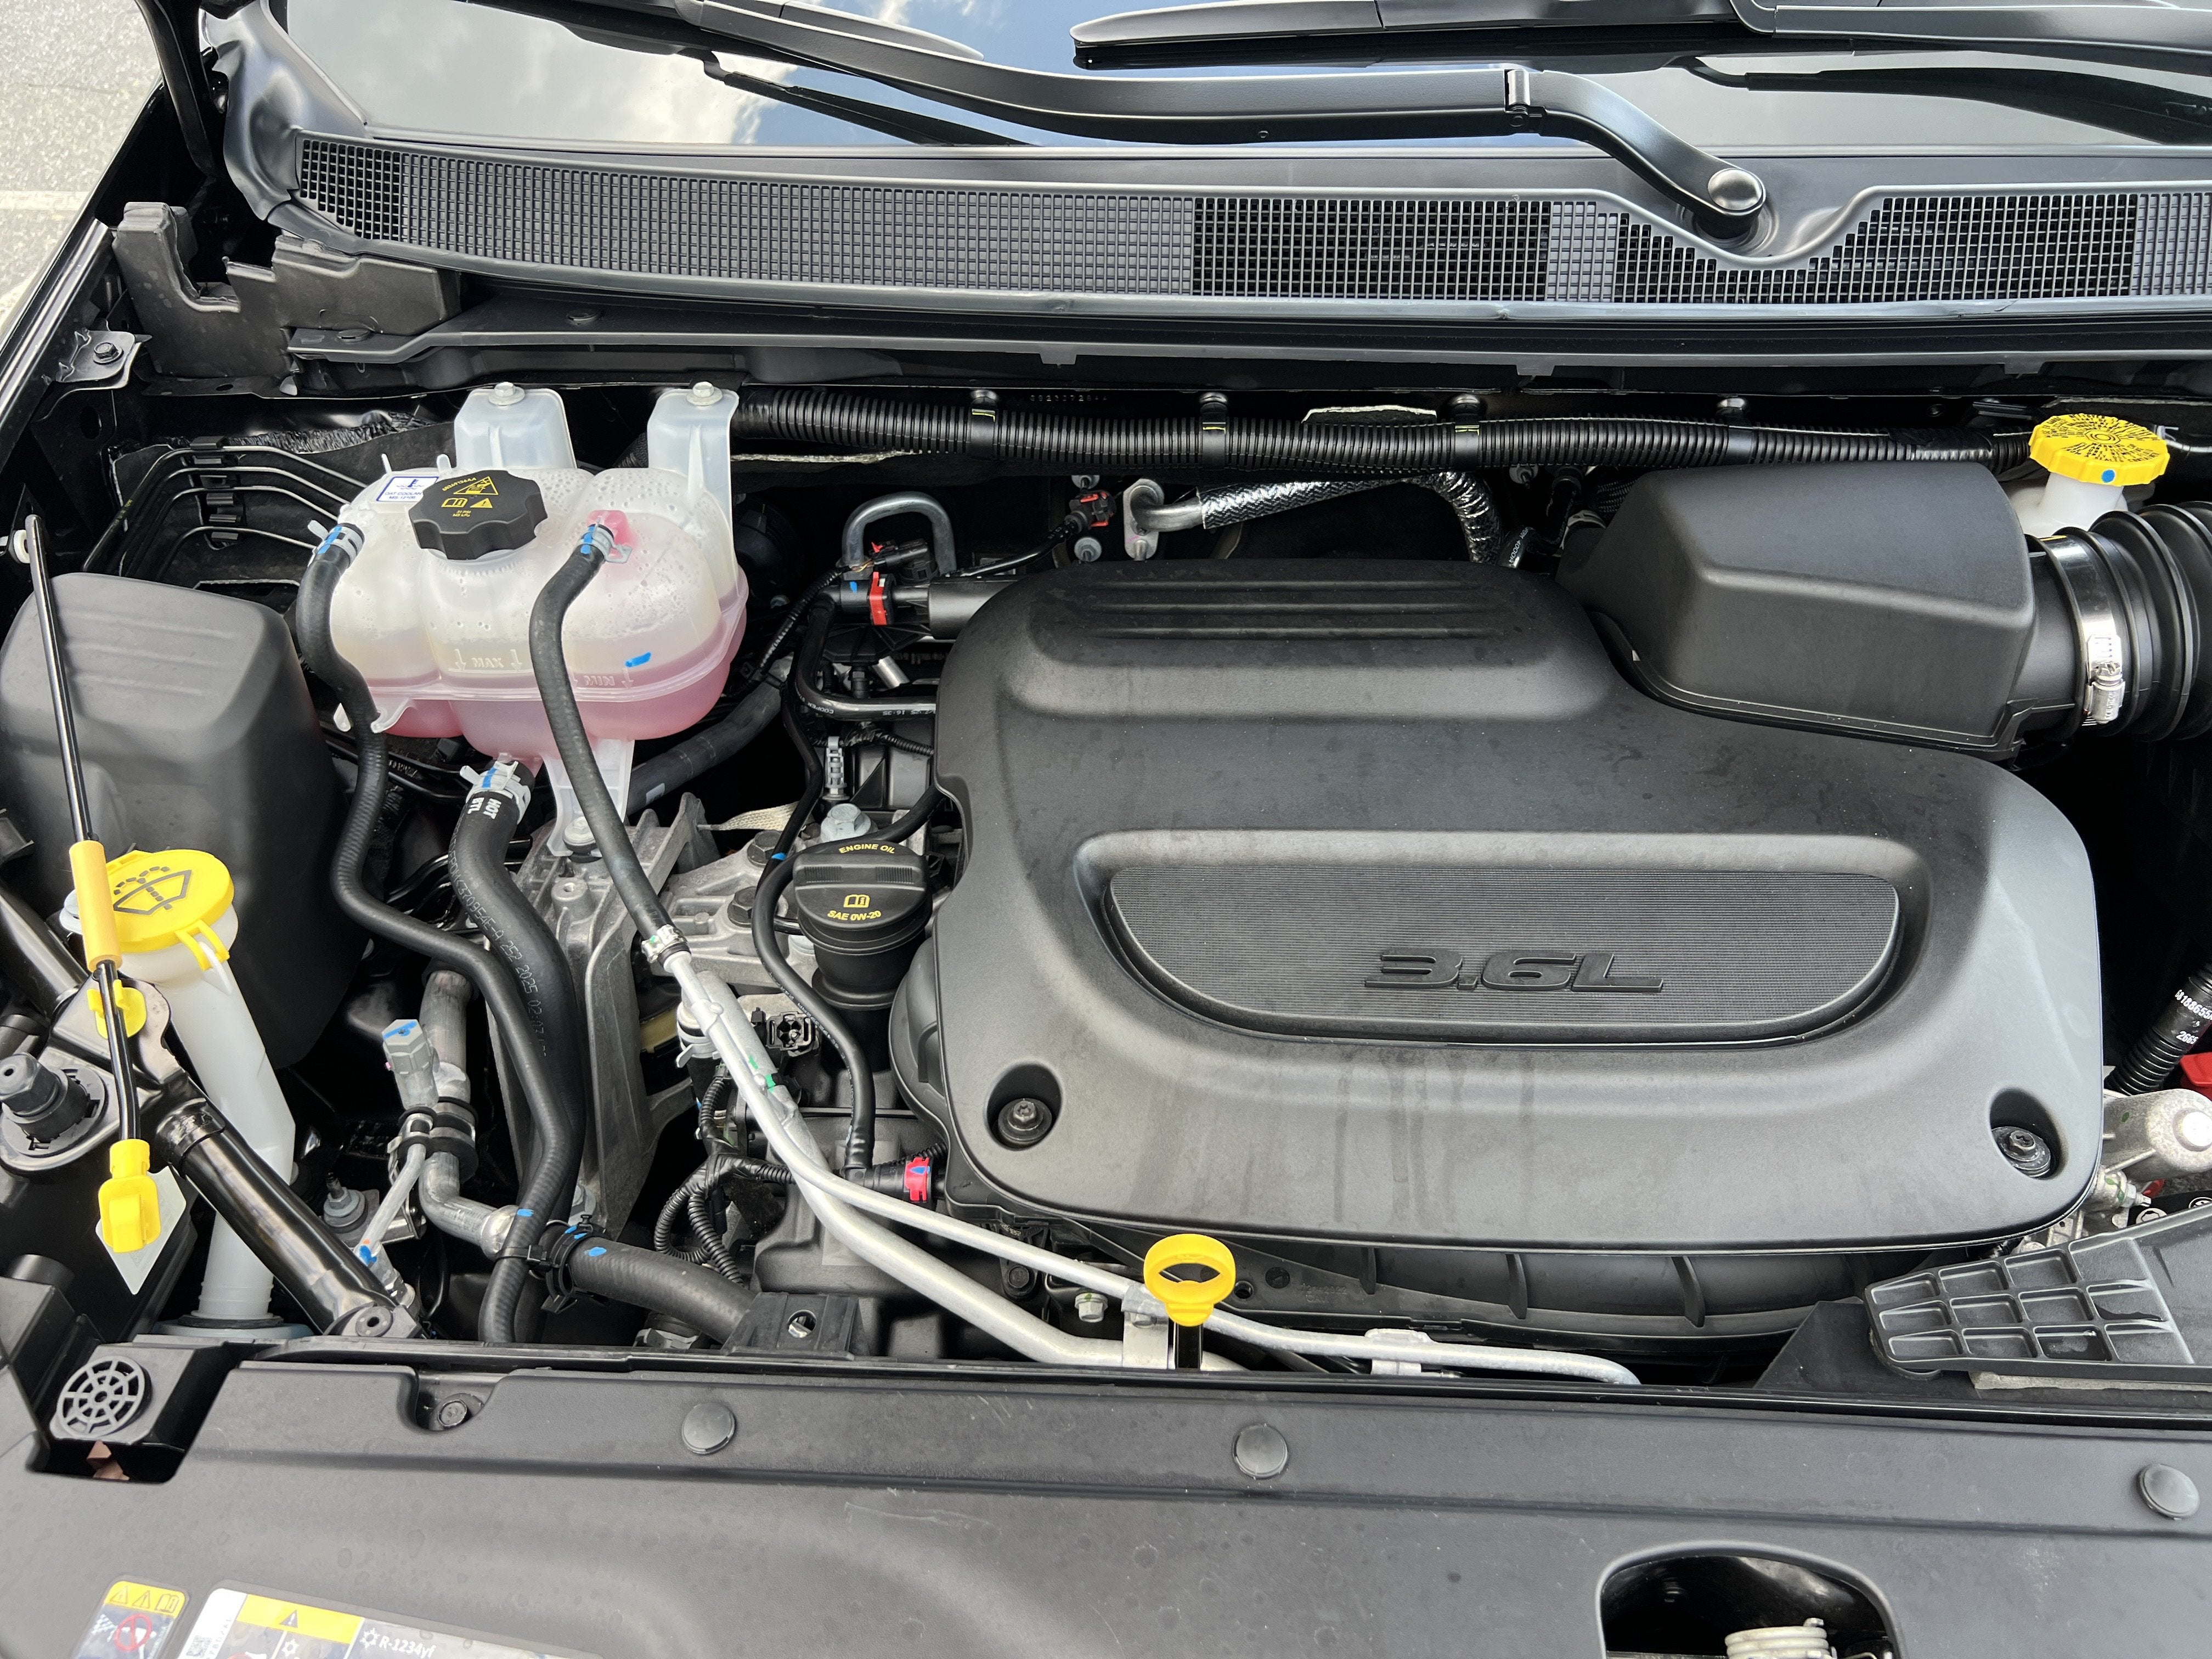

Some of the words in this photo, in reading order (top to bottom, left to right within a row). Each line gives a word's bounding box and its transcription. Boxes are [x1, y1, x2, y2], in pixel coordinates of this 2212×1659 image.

[471, 657, 504, 668] MAX
[584, 675, 616, 686] MIN
[483, 798, 502, 820] HOT
[839, 844, 878, 854] ENGINE
[880, 845, 895, 854] OIL
[827, 910, 850, 921] SAE
[850, 910, 882, 921] 0W-20
[1365, 948, 1663, 992] 3.6L
[516, 964, 538, 994] 2025
[378, 1635, 436, 1659] R-1234yf
